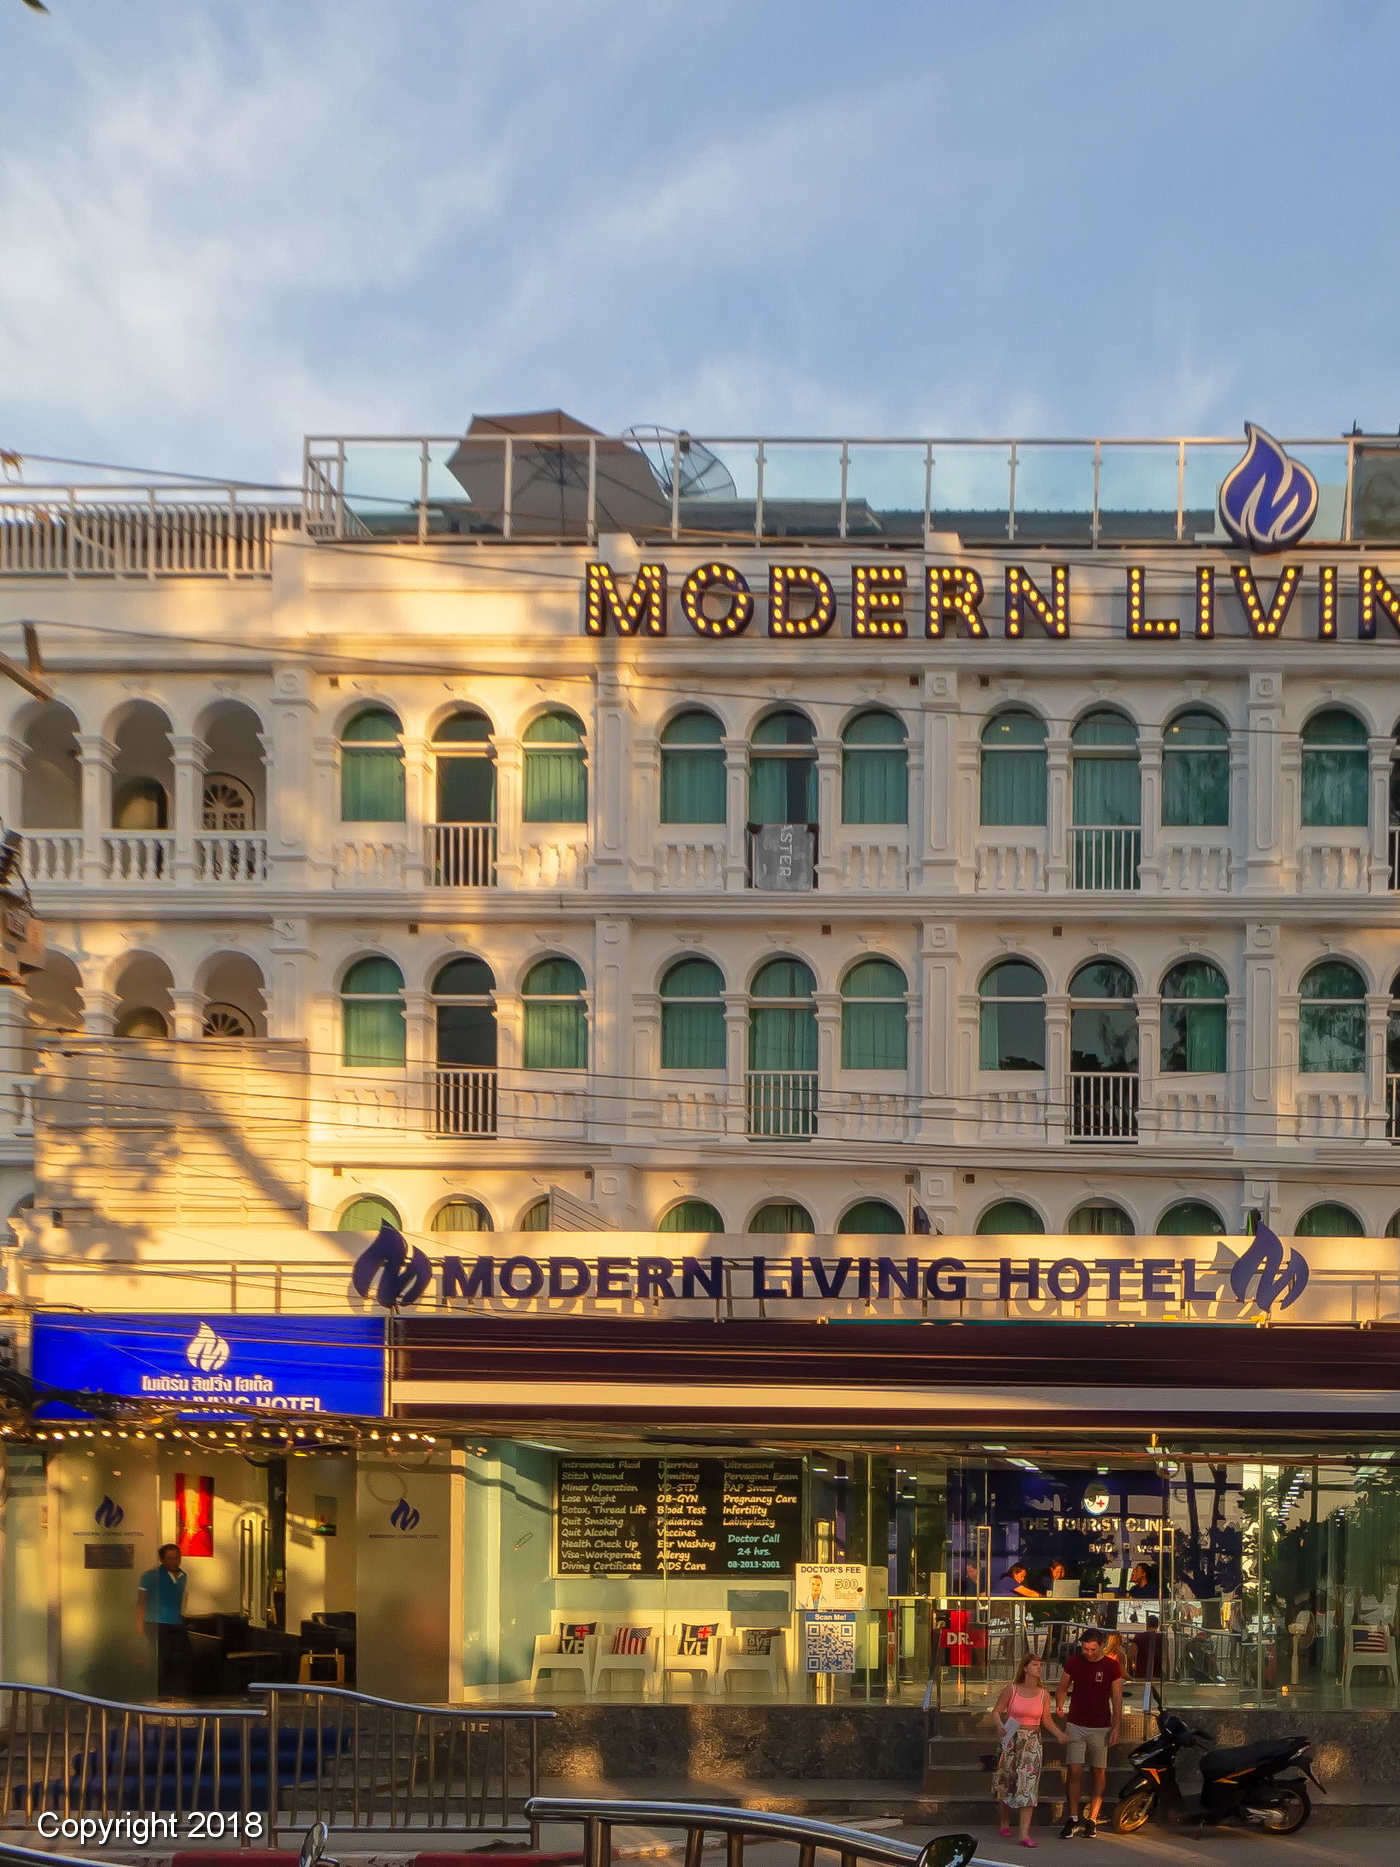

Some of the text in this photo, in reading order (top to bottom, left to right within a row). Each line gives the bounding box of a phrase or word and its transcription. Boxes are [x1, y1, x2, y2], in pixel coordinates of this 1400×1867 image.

[585, 561, 1070, 638] MODERN
[442, 1255, 1219, 1302] MODERN LIVING HOTEL
[658, 1473, 700, 1482] Vmiting
[561, 1483, 639, 1496] Minor Operation
[561, 1494, 581, 1503] Lose
[656, 1494, 699, 1503] OB-GYN
[723, 1494, 798, 1505] Pregnancy Care
[593, 1505, 626, 1514] Thread
[629, 1505, 647, 1514] Lift
[687, 1506, 707, 1514] Test
[723, 1505, 768, 1517] Infertility
[561, 1517, 624, 1528] Quit Smoking
[561, 1528, 618, 1537] Quit Alcohol
[727, 1534, 781, 1543] Doctor Call
[561, 1539, 639, 1551] Health Check Up
[677, 1539, 716, 1551] Washing
[737, 1548, 752, 1556] 24
[561, 1561, 642, 1572] Diving Certificate
[684, 1562, 707, 1571] Care
[800, 1565, 862, 1574] DOCTOR'S FEE
[834, 1578, 859, 1590] 500
[814, 1613, 847, 1621] Scan Me!
[946, 1632, 974, 1646] DR.
